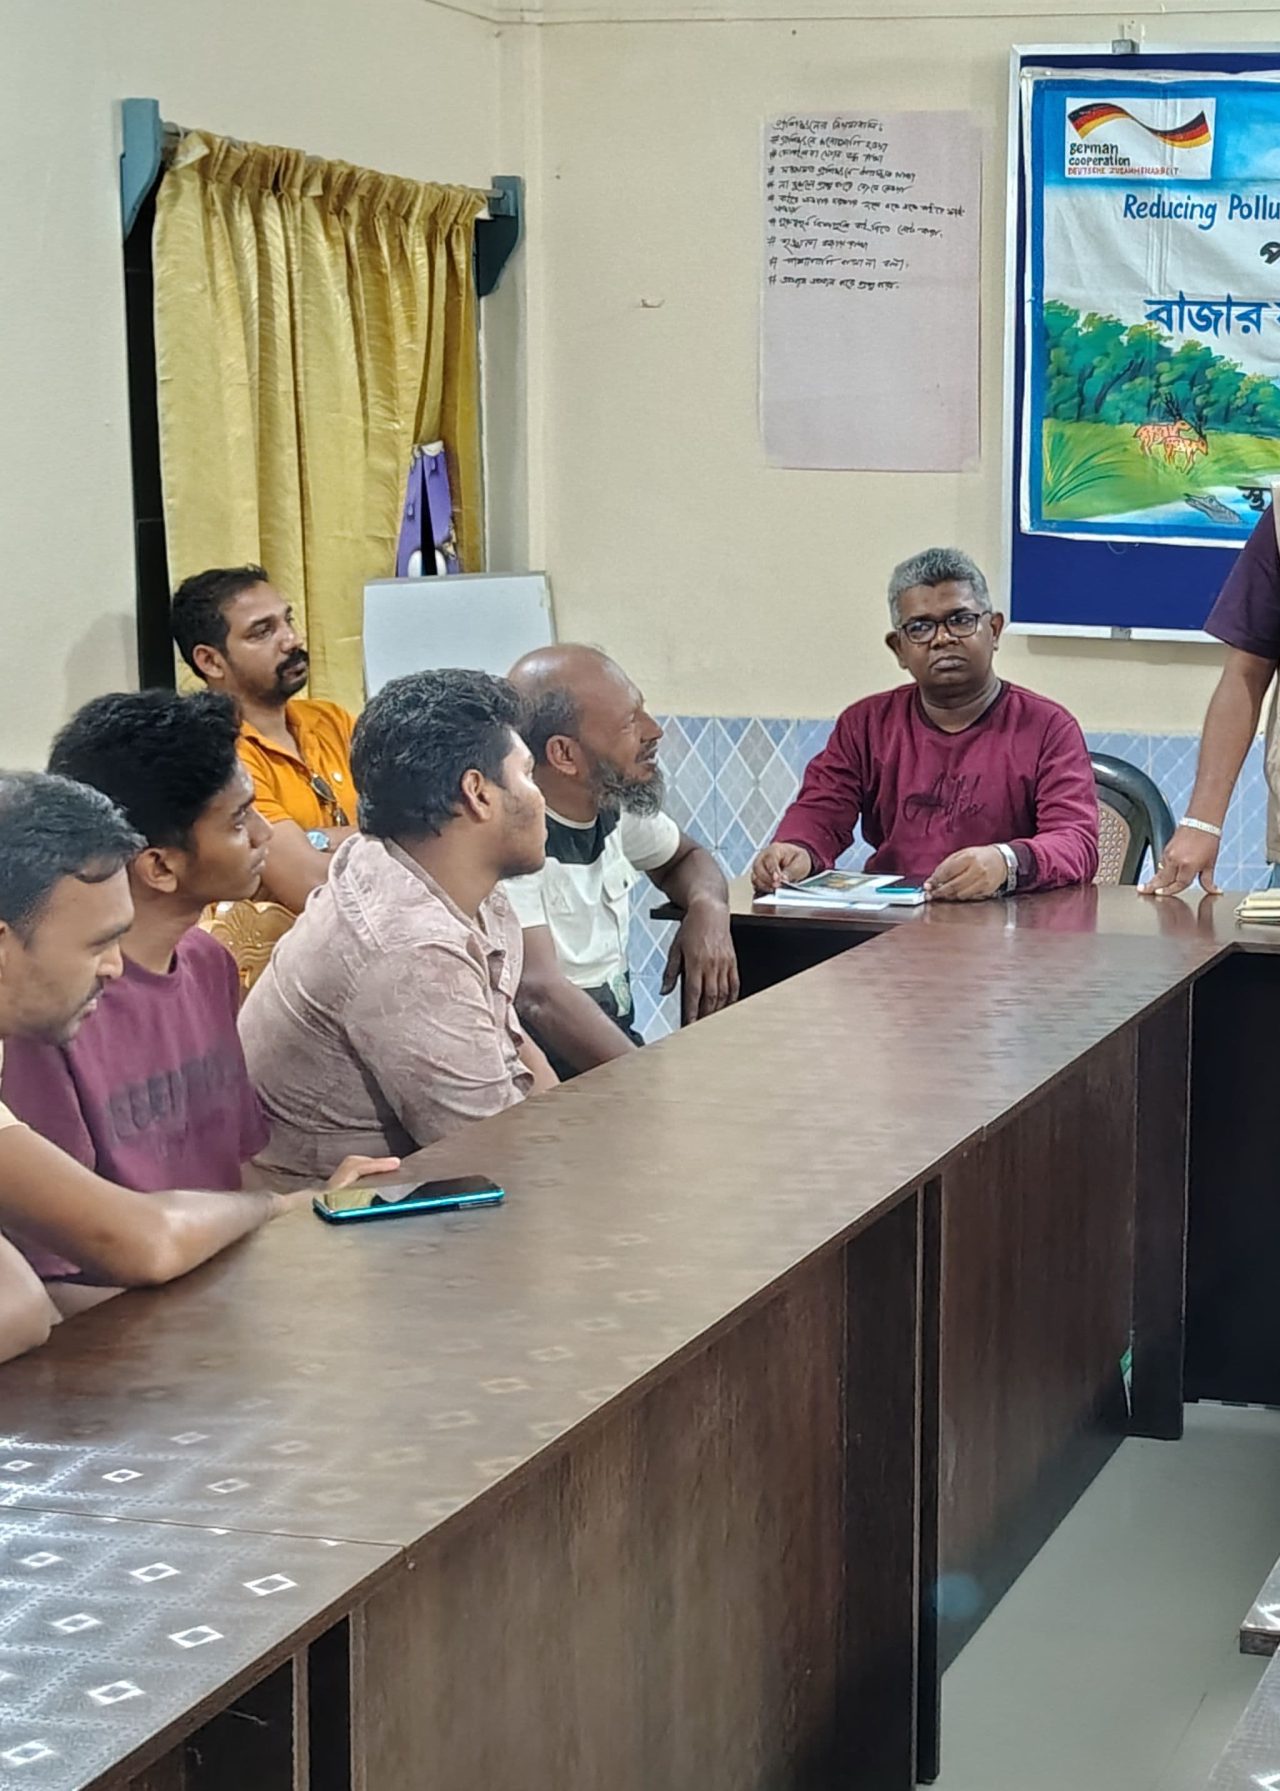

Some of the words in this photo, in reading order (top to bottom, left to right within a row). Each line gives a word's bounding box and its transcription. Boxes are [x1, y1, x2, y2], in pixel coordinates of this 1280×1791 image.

[1070, 142, 1119, 155] german
[1068, 156, 1131, 166] cooperation
[1123, 194, 1217, 230] Reducing
[1144, 292, 1267, 335] বাজার
